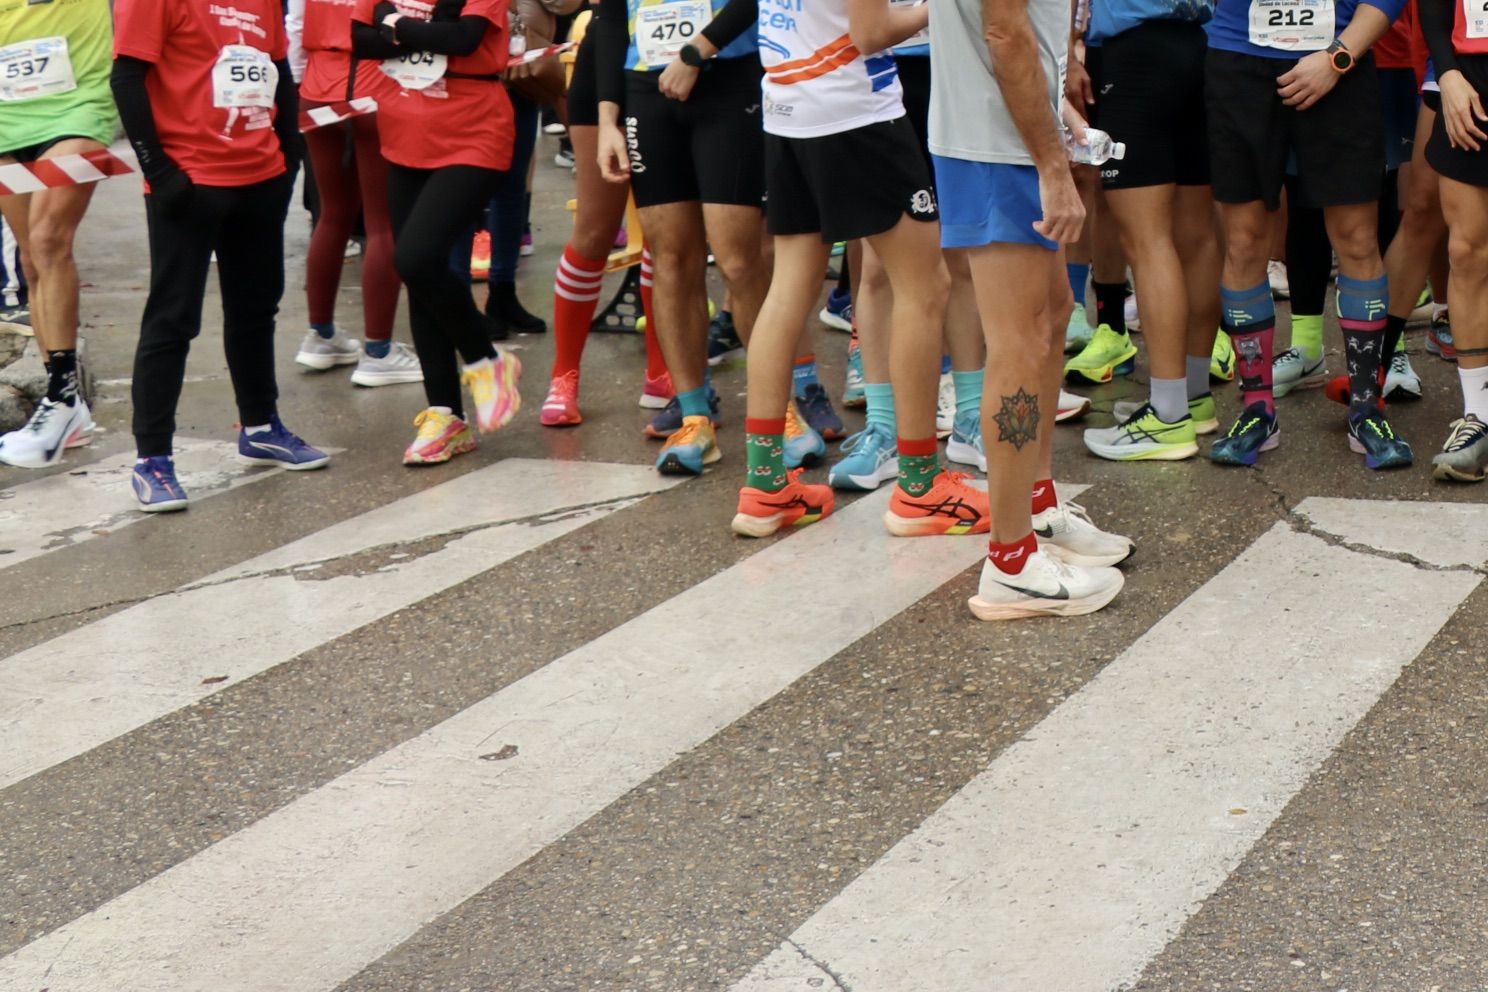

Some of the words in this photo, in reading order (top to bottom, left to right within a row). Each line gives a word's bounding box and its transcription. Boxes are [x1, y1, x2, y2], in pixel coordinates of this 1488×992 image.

[1269, 9, 1314, 26] 212
[651, 21, 694, 40] 470
[6, 57, 49, 78] 537
